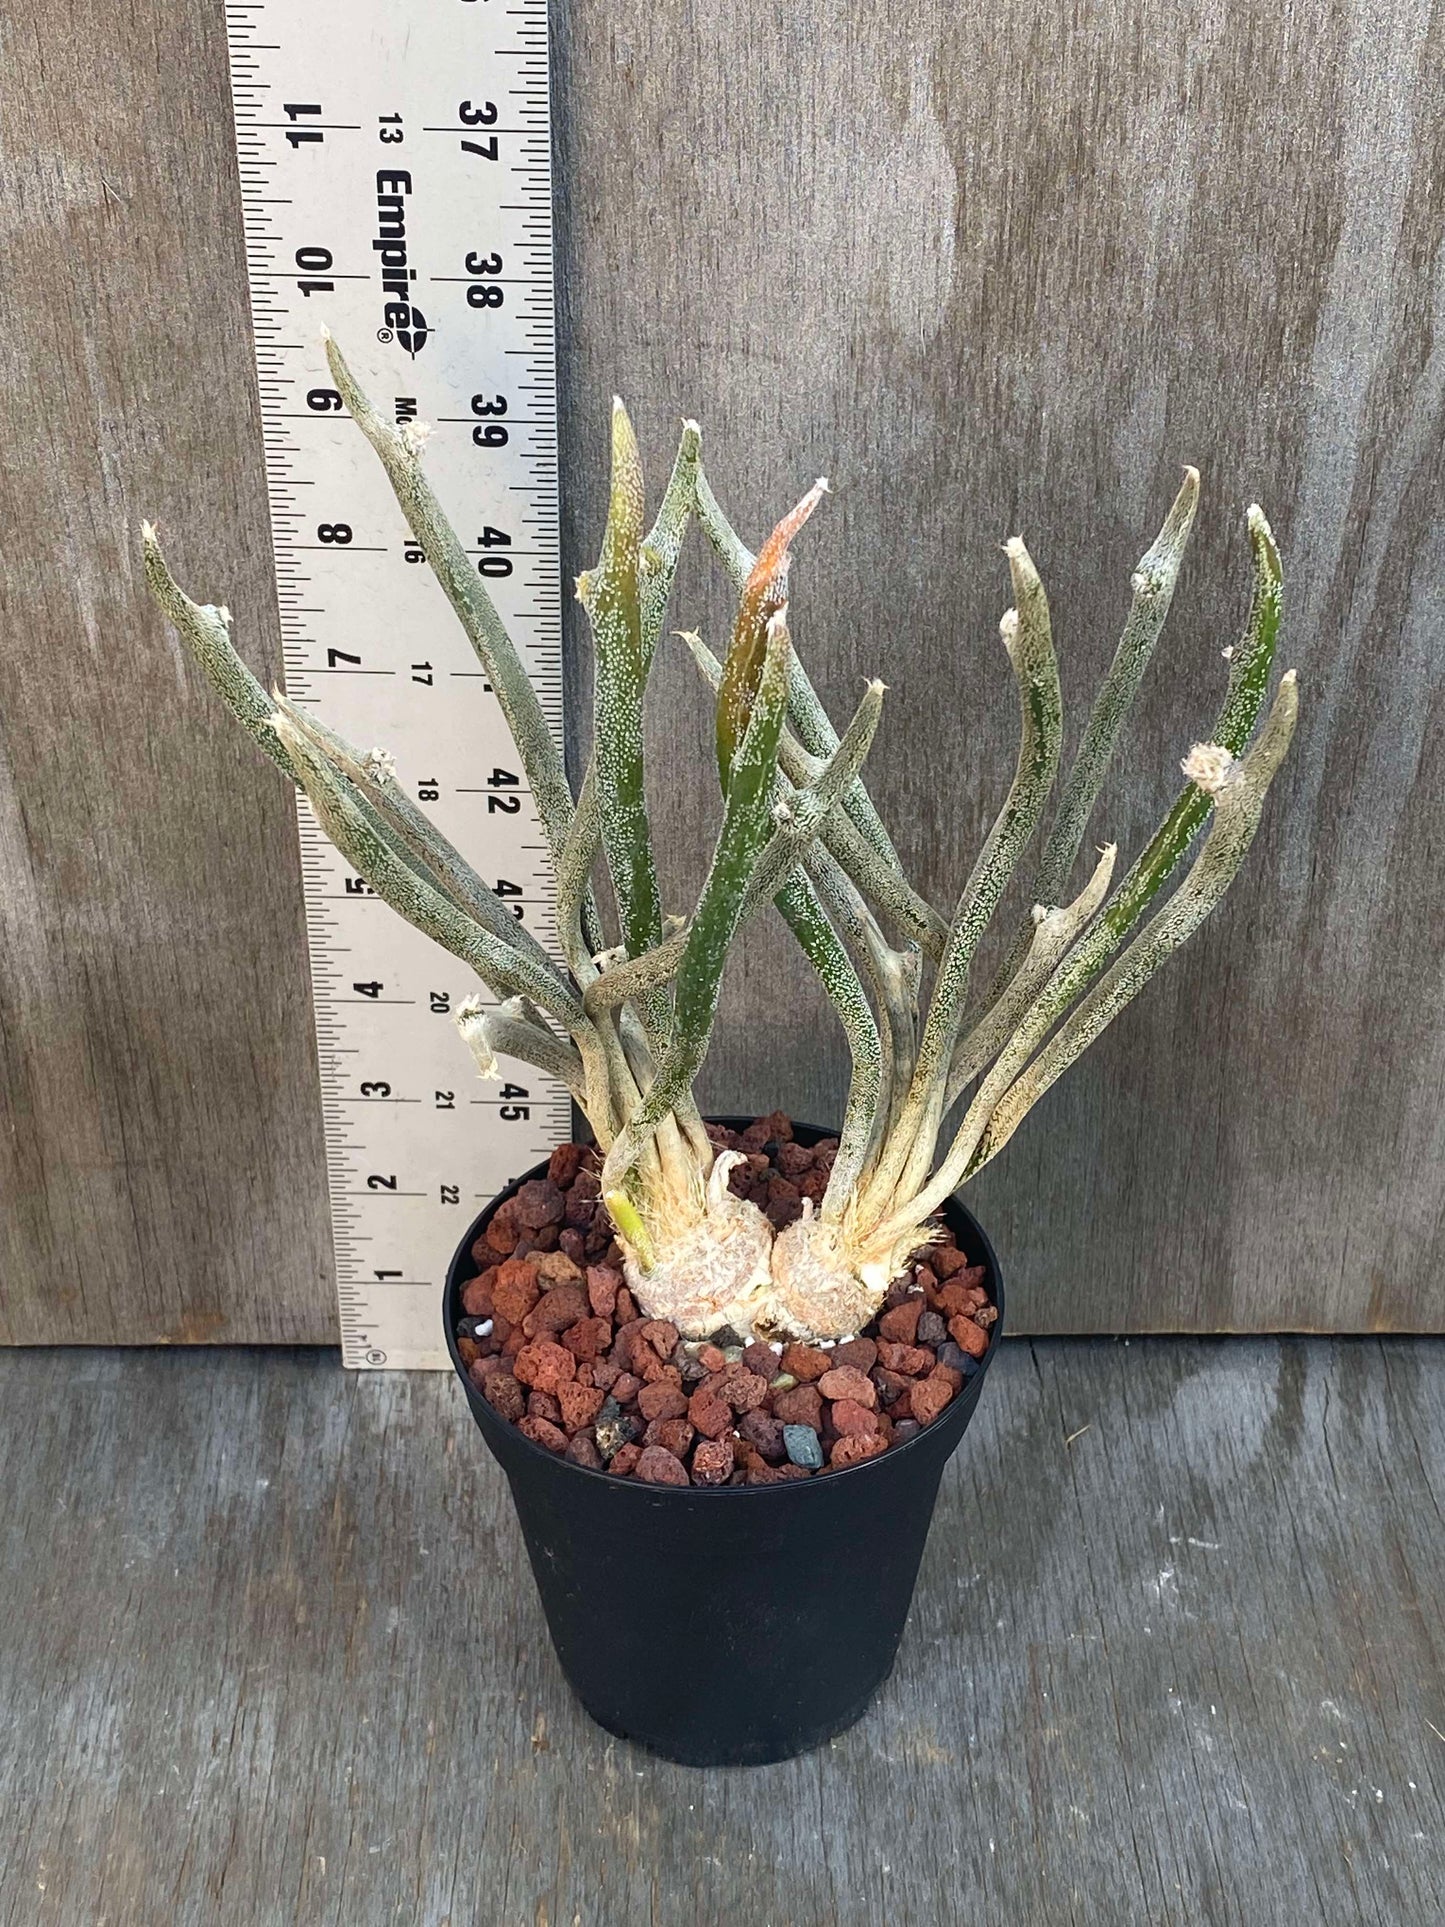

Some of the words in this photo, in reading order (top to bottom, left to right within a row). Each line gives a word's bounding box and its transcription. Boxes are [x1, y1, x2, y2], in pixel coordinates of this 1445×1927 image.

[283, 103, 324, 149] 11
[379, 112, 404, 144] 13
[459, 100, 499, 161] 37
[372, 169, 417, 329] Empire
[295, 246, 335, 298] 10
[465, 252, 504, 309] 38
[471, 393, 509, 448] 39
[317, 523, 353, 545] 8
[404, 539, 426, 564] 16
[477, 526, 513, 578] 40
[327, 648, 361, 668] 7
[411, 661, 433, 687] 17
[418, 778, 439, 802] 18
[487, 768, 520, 814] 42
[345, 878, 374, 894] 5
[353, 981, 383, 998] 4
[430, 991, 450, 1013] 20
[360, 1082, 391, 1097] 3
[435, 1091, 454, 1110] 21
[499, 1083, 529, 1121] 45
[367, 1175, 397, 1190] 2
[441, 1185, 459, 1204] 22
[374, 1270, 403, 1280] 1
